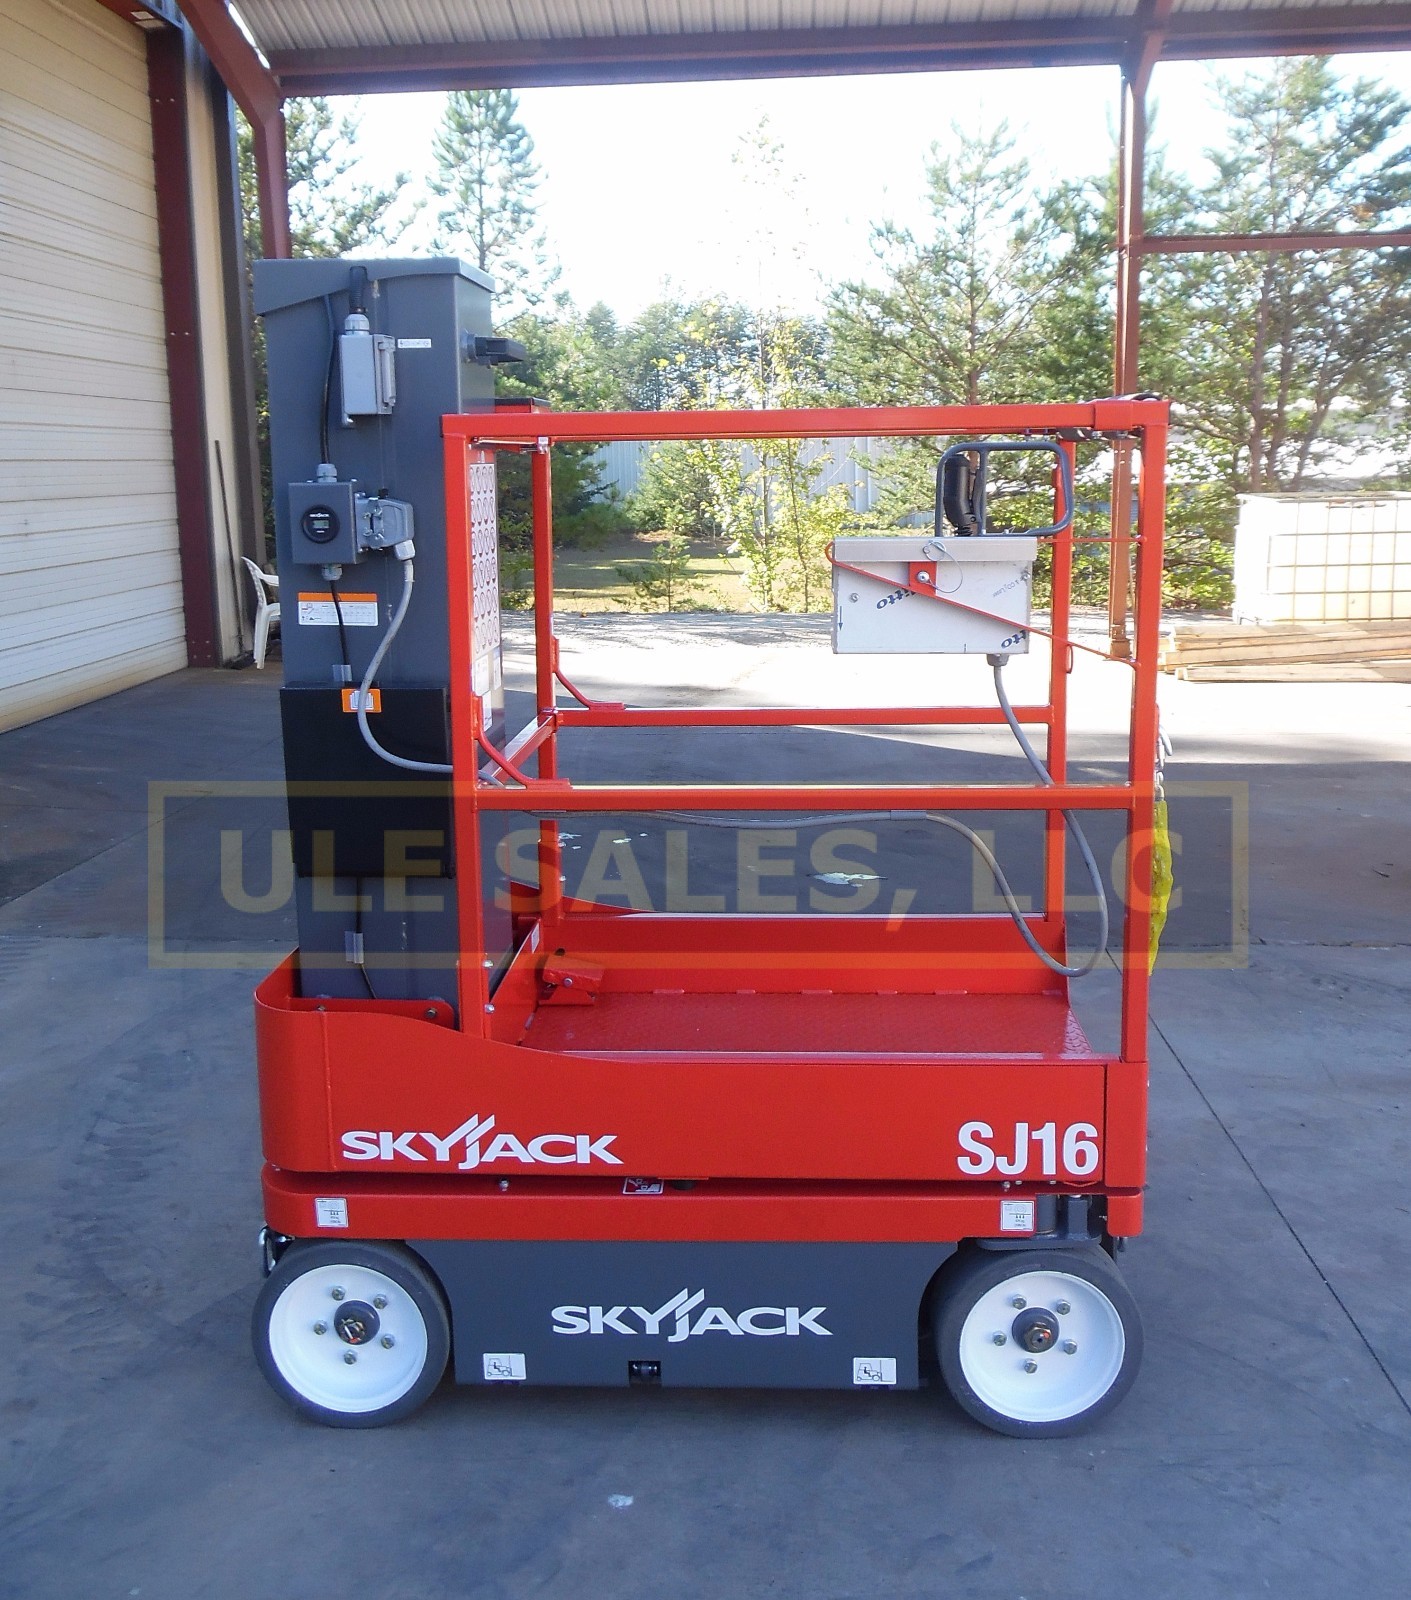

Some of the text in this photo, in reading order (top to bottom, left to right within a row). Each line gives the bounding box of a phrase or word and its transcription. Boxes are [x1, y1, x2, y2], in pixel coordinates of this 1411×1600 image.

[341, 1113, 625, 1170] SKYJACK
[957, 1121, 1099, 1176] SJ16
[551, 1287, 834, 1342] SKYJACK
